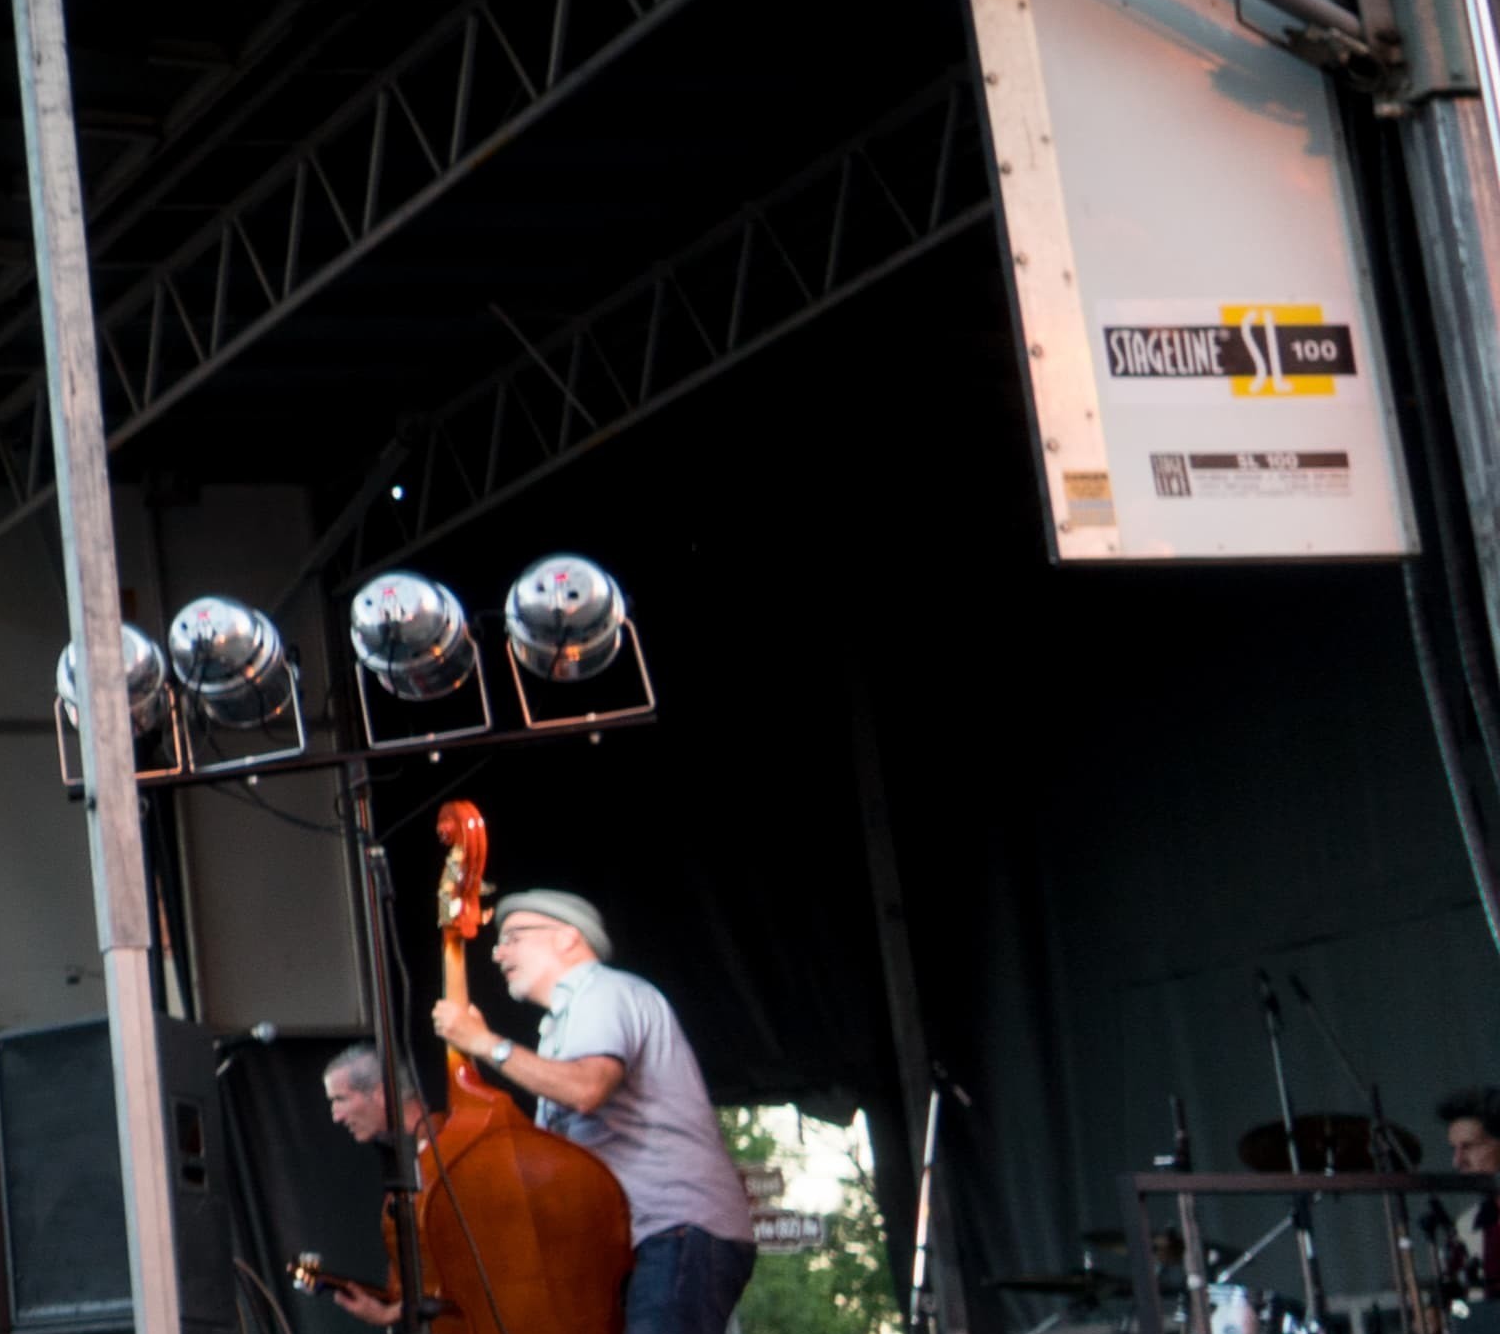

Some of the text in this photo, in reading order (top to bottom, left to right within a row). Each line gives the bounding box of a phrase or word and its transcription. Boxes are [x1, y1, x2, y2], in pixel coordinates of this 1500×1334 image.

[1109, 309, 1337, 394] STAGELINE SL 100
